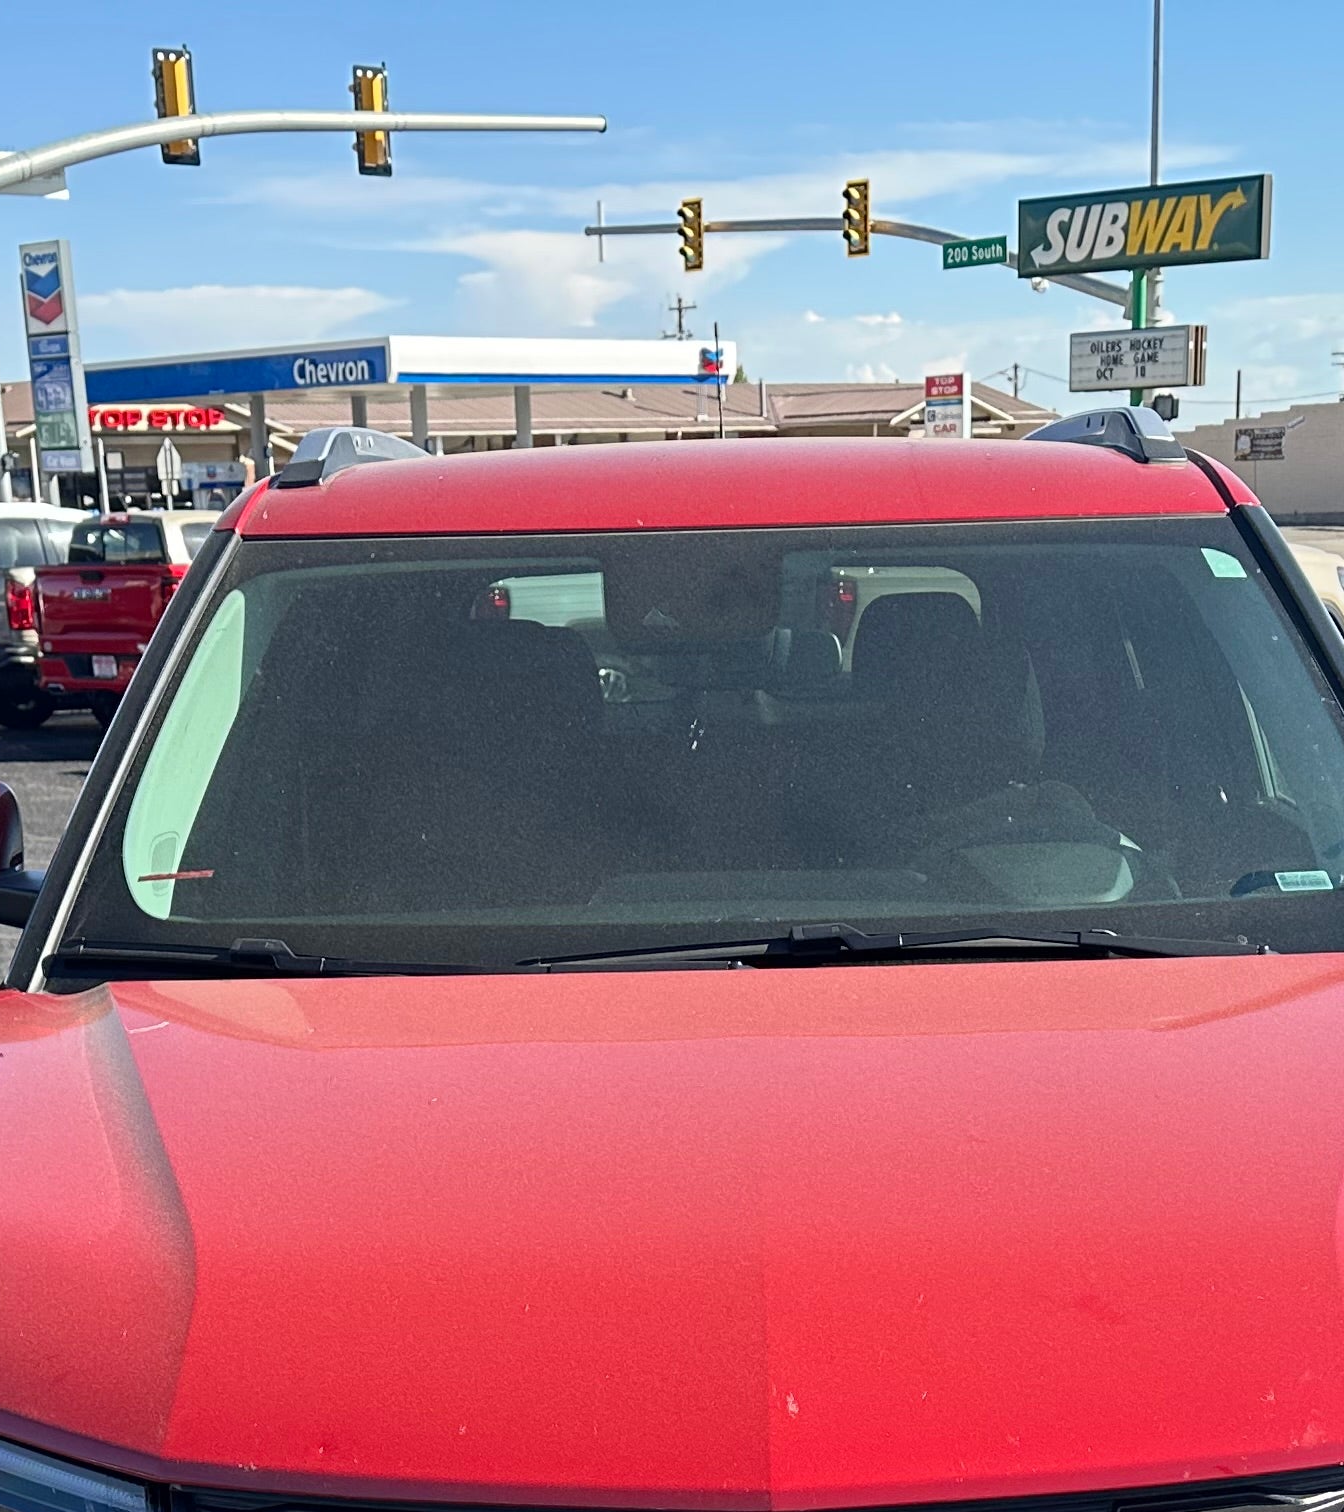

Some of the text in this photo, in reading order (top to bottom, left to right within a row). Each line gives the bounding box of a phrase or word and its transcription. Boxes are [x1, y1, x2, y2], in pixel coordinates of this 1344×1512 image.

[1030, 184, 1247, 269] SUBWAY
[947, 243, 1003, 264] 200 South
[1090, 338, 1164, 355] OILERS HOCKEY
[1100, 351, 1159, 367] HOME GAME
[293, 358, 369, 385] Chevron
[1096, 367, 1114, 380] OCT
[930, 385, 958, 396] STOP
[149, 408, 225, 430] STOP
[933, 424, 957, 433] CAR
